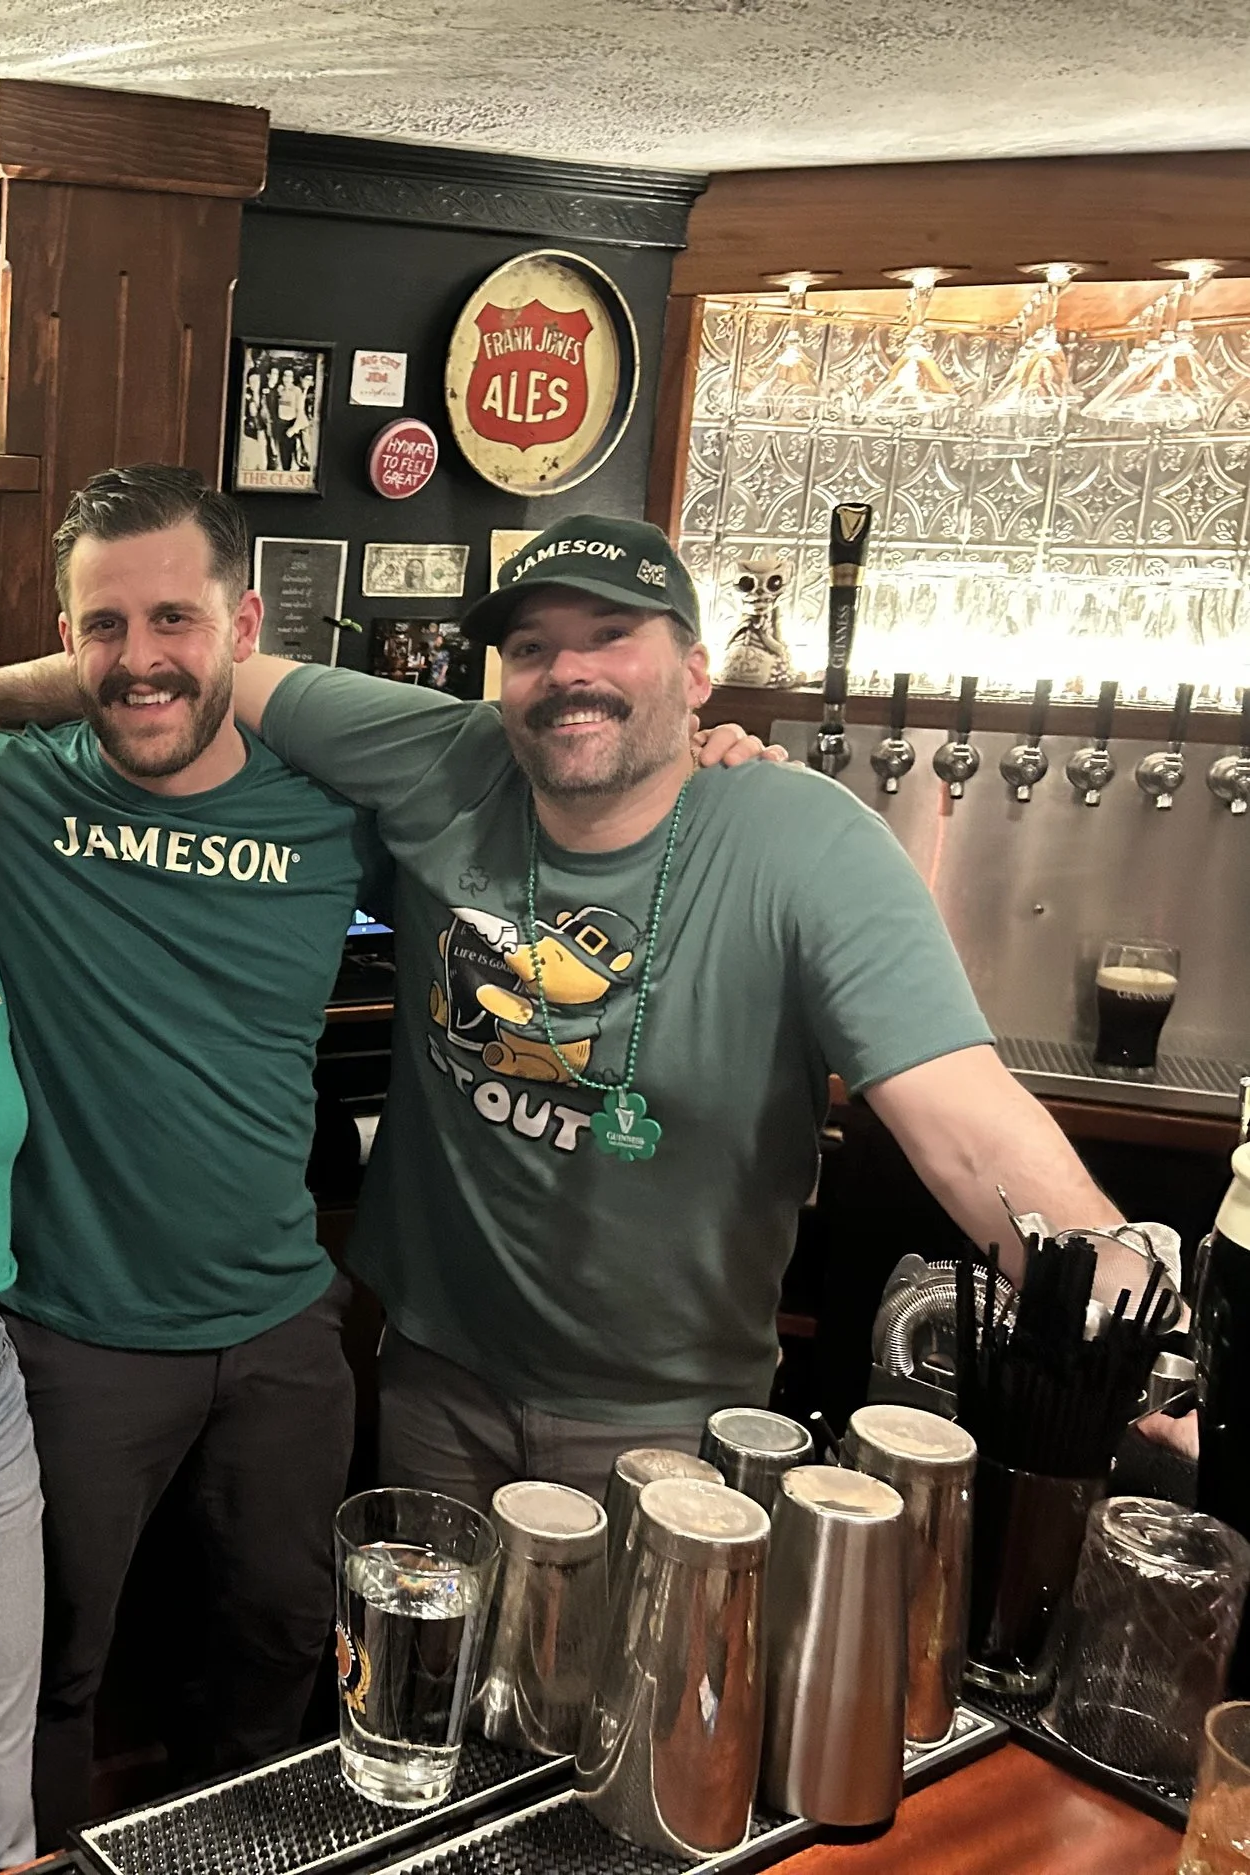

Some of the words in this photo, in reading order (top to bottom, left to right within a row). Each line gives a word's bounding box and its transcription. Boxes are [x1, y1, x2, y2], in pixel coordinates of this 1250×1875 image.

[483, 326, 534, 359] FRANK
[535, 326, 583, 366] JONES
[481, 370, 570, 423] ALES
[382, 454, 400, 469] TO
[400, 457, 428, 475] FEEL
[386, 438, 434, 459] HYDRATE
[242, 471, 268, 485] THE
[382, 470, 421, 490] GREAT
[511, 539, 623, 582] JAMESON
[831, 604, 850, 669] GUINNESS
[53, 816, 292, 883] JAMESON
